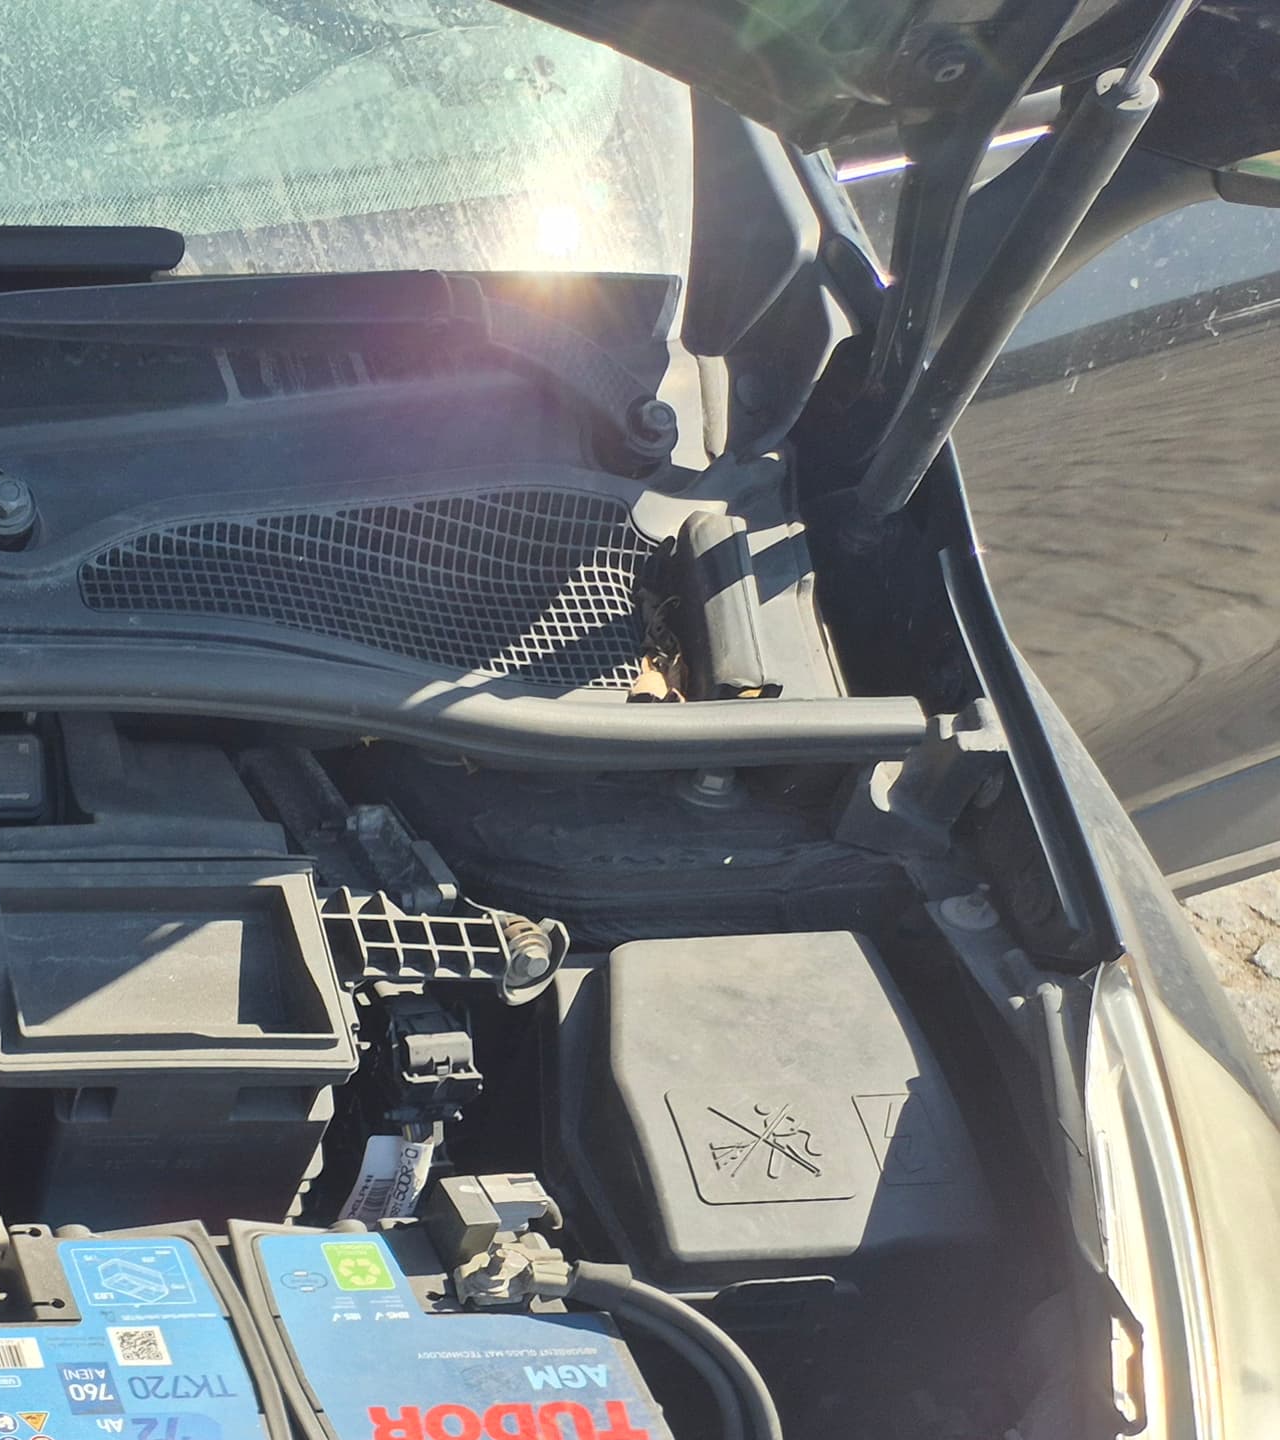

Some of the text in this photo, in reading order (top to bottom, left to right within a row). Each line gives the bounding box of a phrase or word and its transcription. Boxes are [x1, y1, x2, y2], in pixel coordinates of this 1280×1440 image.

[417, 1348, 482, 1360] TECHNOLOGY
[523, 1362, 608, 1391] AGM
[68, 1381, 115, 1401] 760
[128, 1374, 236, 1400] TK720
[96, 1416, 125, 1433] Ah
